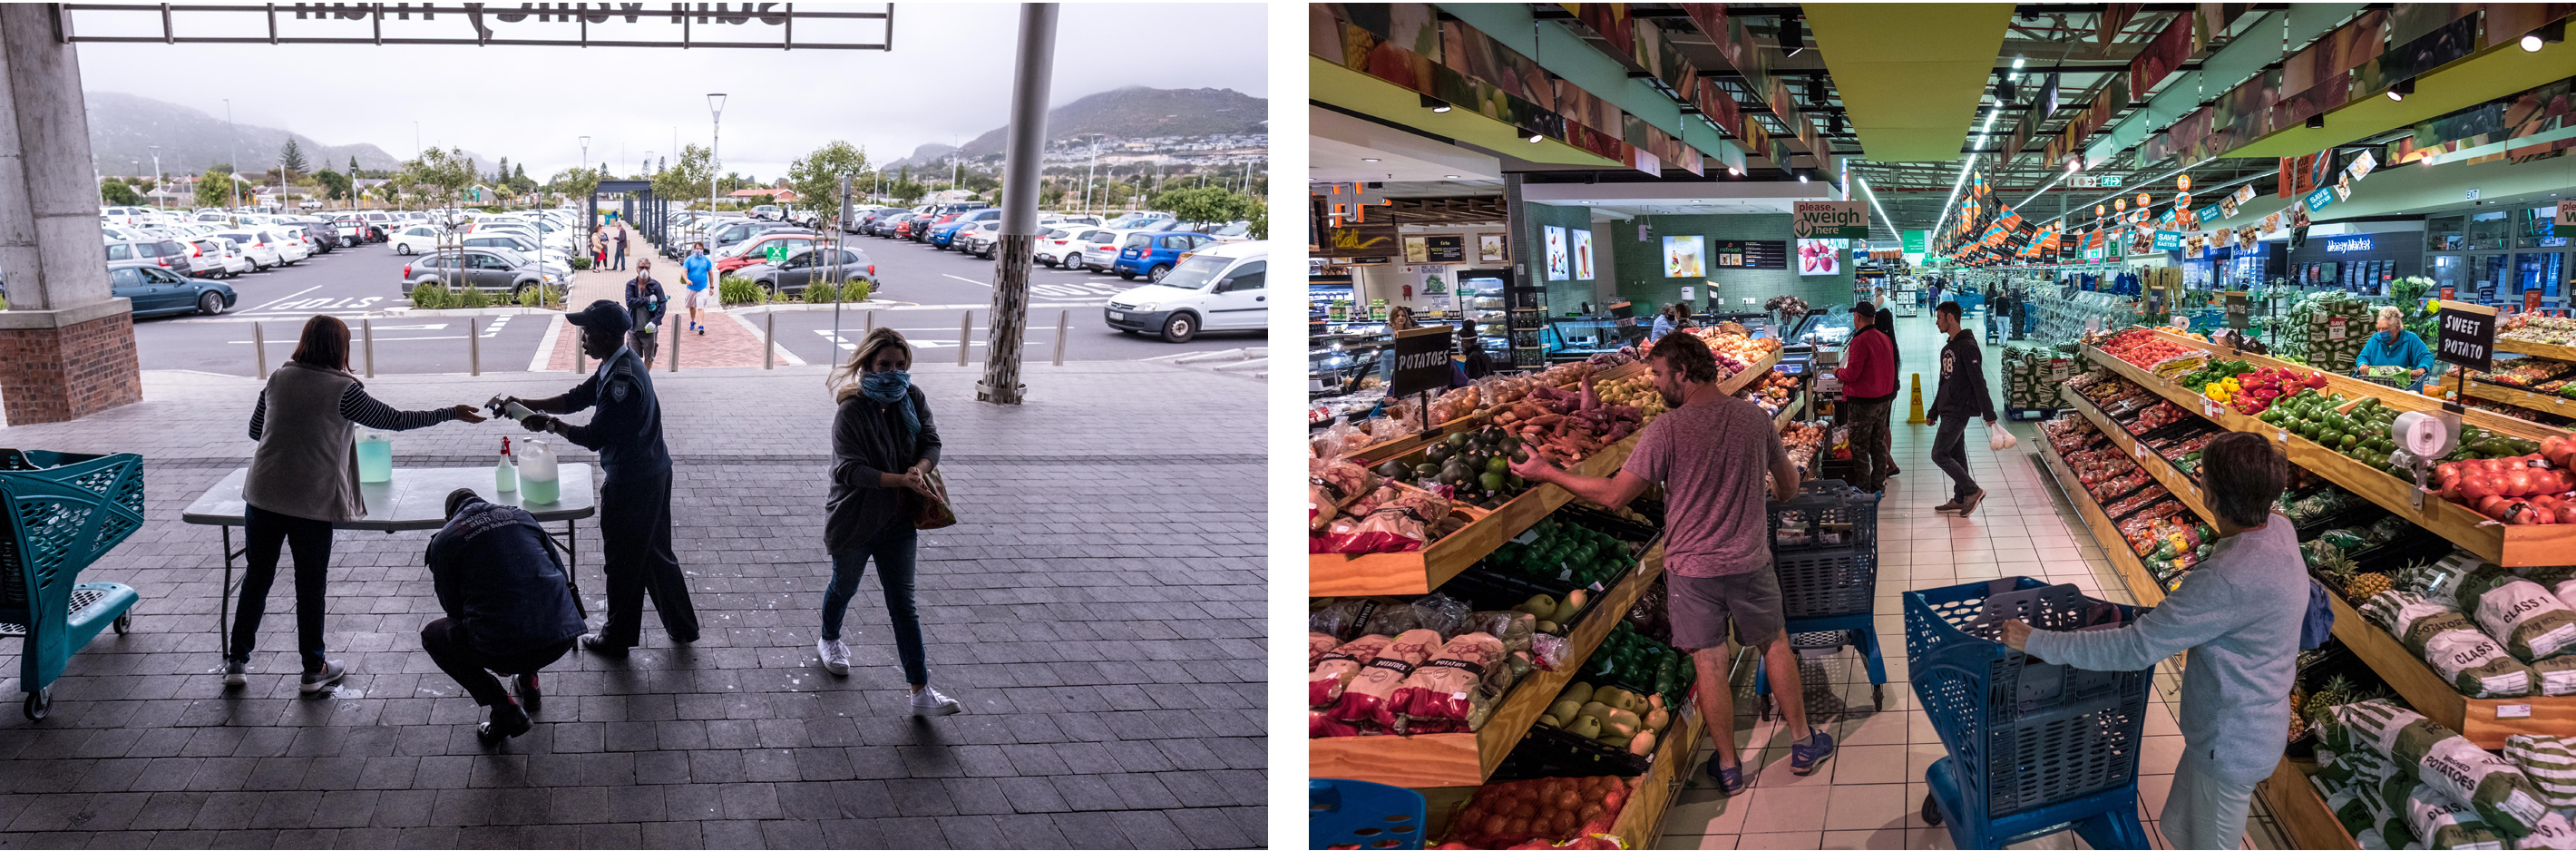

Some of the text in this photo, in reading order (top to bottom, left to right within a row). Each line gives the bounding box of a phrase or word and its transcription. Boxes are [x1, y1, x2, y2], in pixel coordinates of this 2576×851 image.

[2289, 177, 2306, 191] FEE!
[2309, 188, 2328, 204] SAVE
[2466, 190, 2478, 201] EXIT
[1799, 202, 1831, 213] please
[2201, 206, 2217, 217] SAVE
[1802, 208, 1859, 228] weigh
[1816, 226, 1839, 234] here
[2158, 233, 2177, 241] SAVE
[2327, 238, 2371, 254] Money Market
[268, 296, 384, 309] STOP
[2444, 315, 2481, 337] SWEET
[2444, 338, 2483, 360] POTATO
[1399, 349, 1449, 371] POTATOES
[464, 519, 519, 542] Security Solutions
[1355, 602, 1374, 628] POTATOES
[2503, 596, 2550, 624] CLASS 1
[2454, 641, 2494, 665] CLASS
[1376, 660, 1407, 670] POTATOES
[1435, 660, 1467, 668] POTATOES
[2424, 756, 2475, 791] POTATOES
